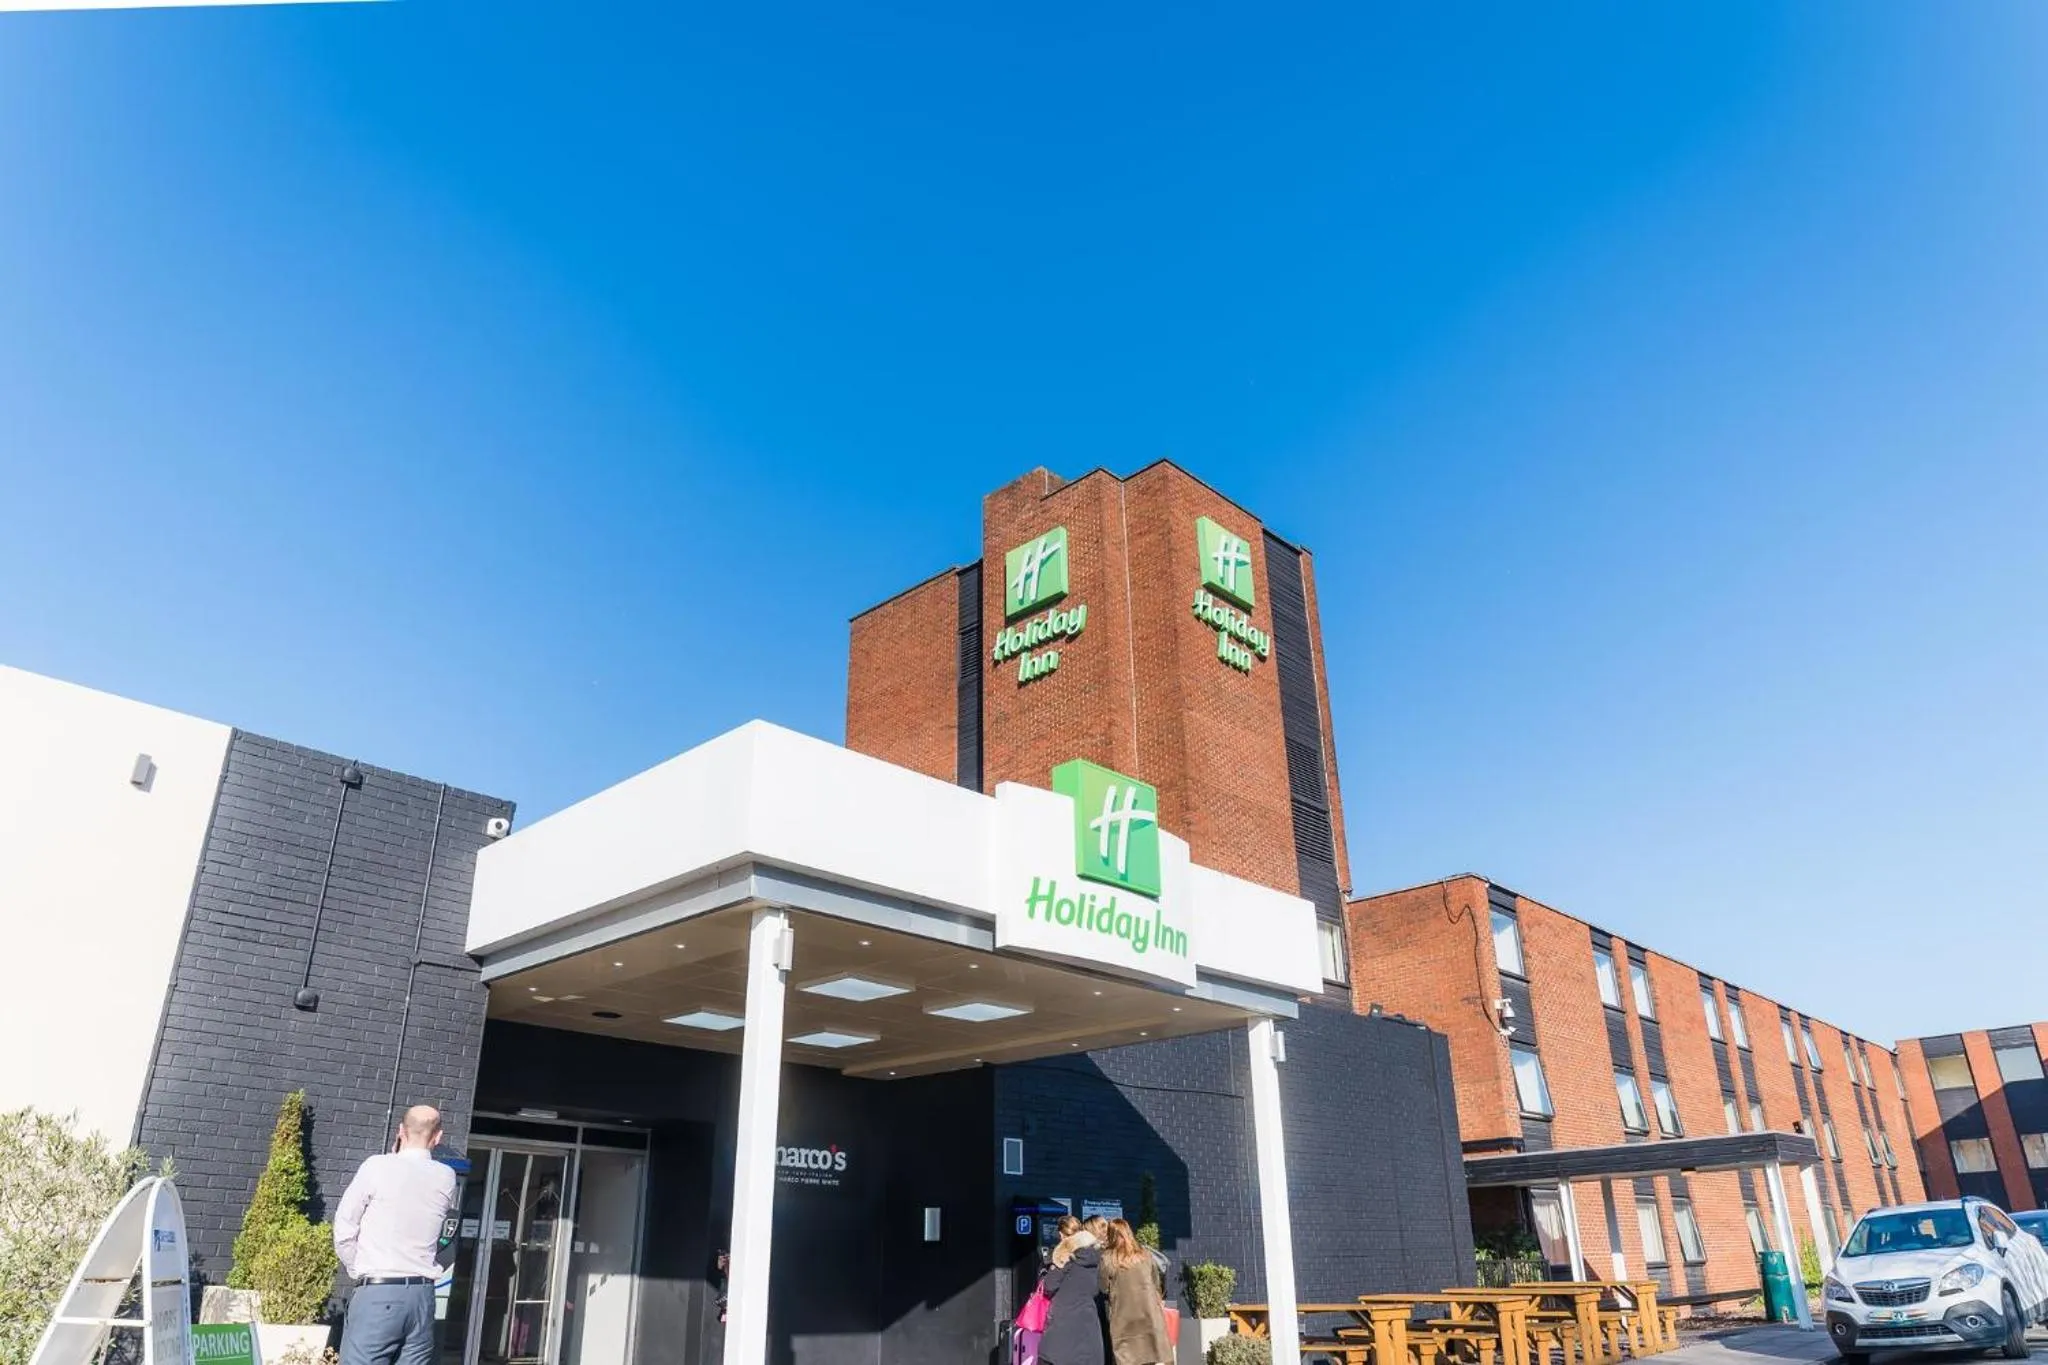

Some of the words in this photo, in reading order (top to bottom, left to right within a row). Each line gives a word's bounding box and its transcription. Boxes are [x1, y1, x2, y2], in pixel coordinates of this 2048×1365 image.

[993, 604, 1088, 661] Holiday
[1192, 589, 1271, 657] Holiday
[1018, 650, 1060, 682] Inn
[1217, 630, 1252, 673] Inn
[1025, 877, 1150, 954] Holiday
[1155, 909, 1188, 959] Inn
[1020, 1218, 1029, 1232] P
[193, 1331, 250, 1359] PARKING
